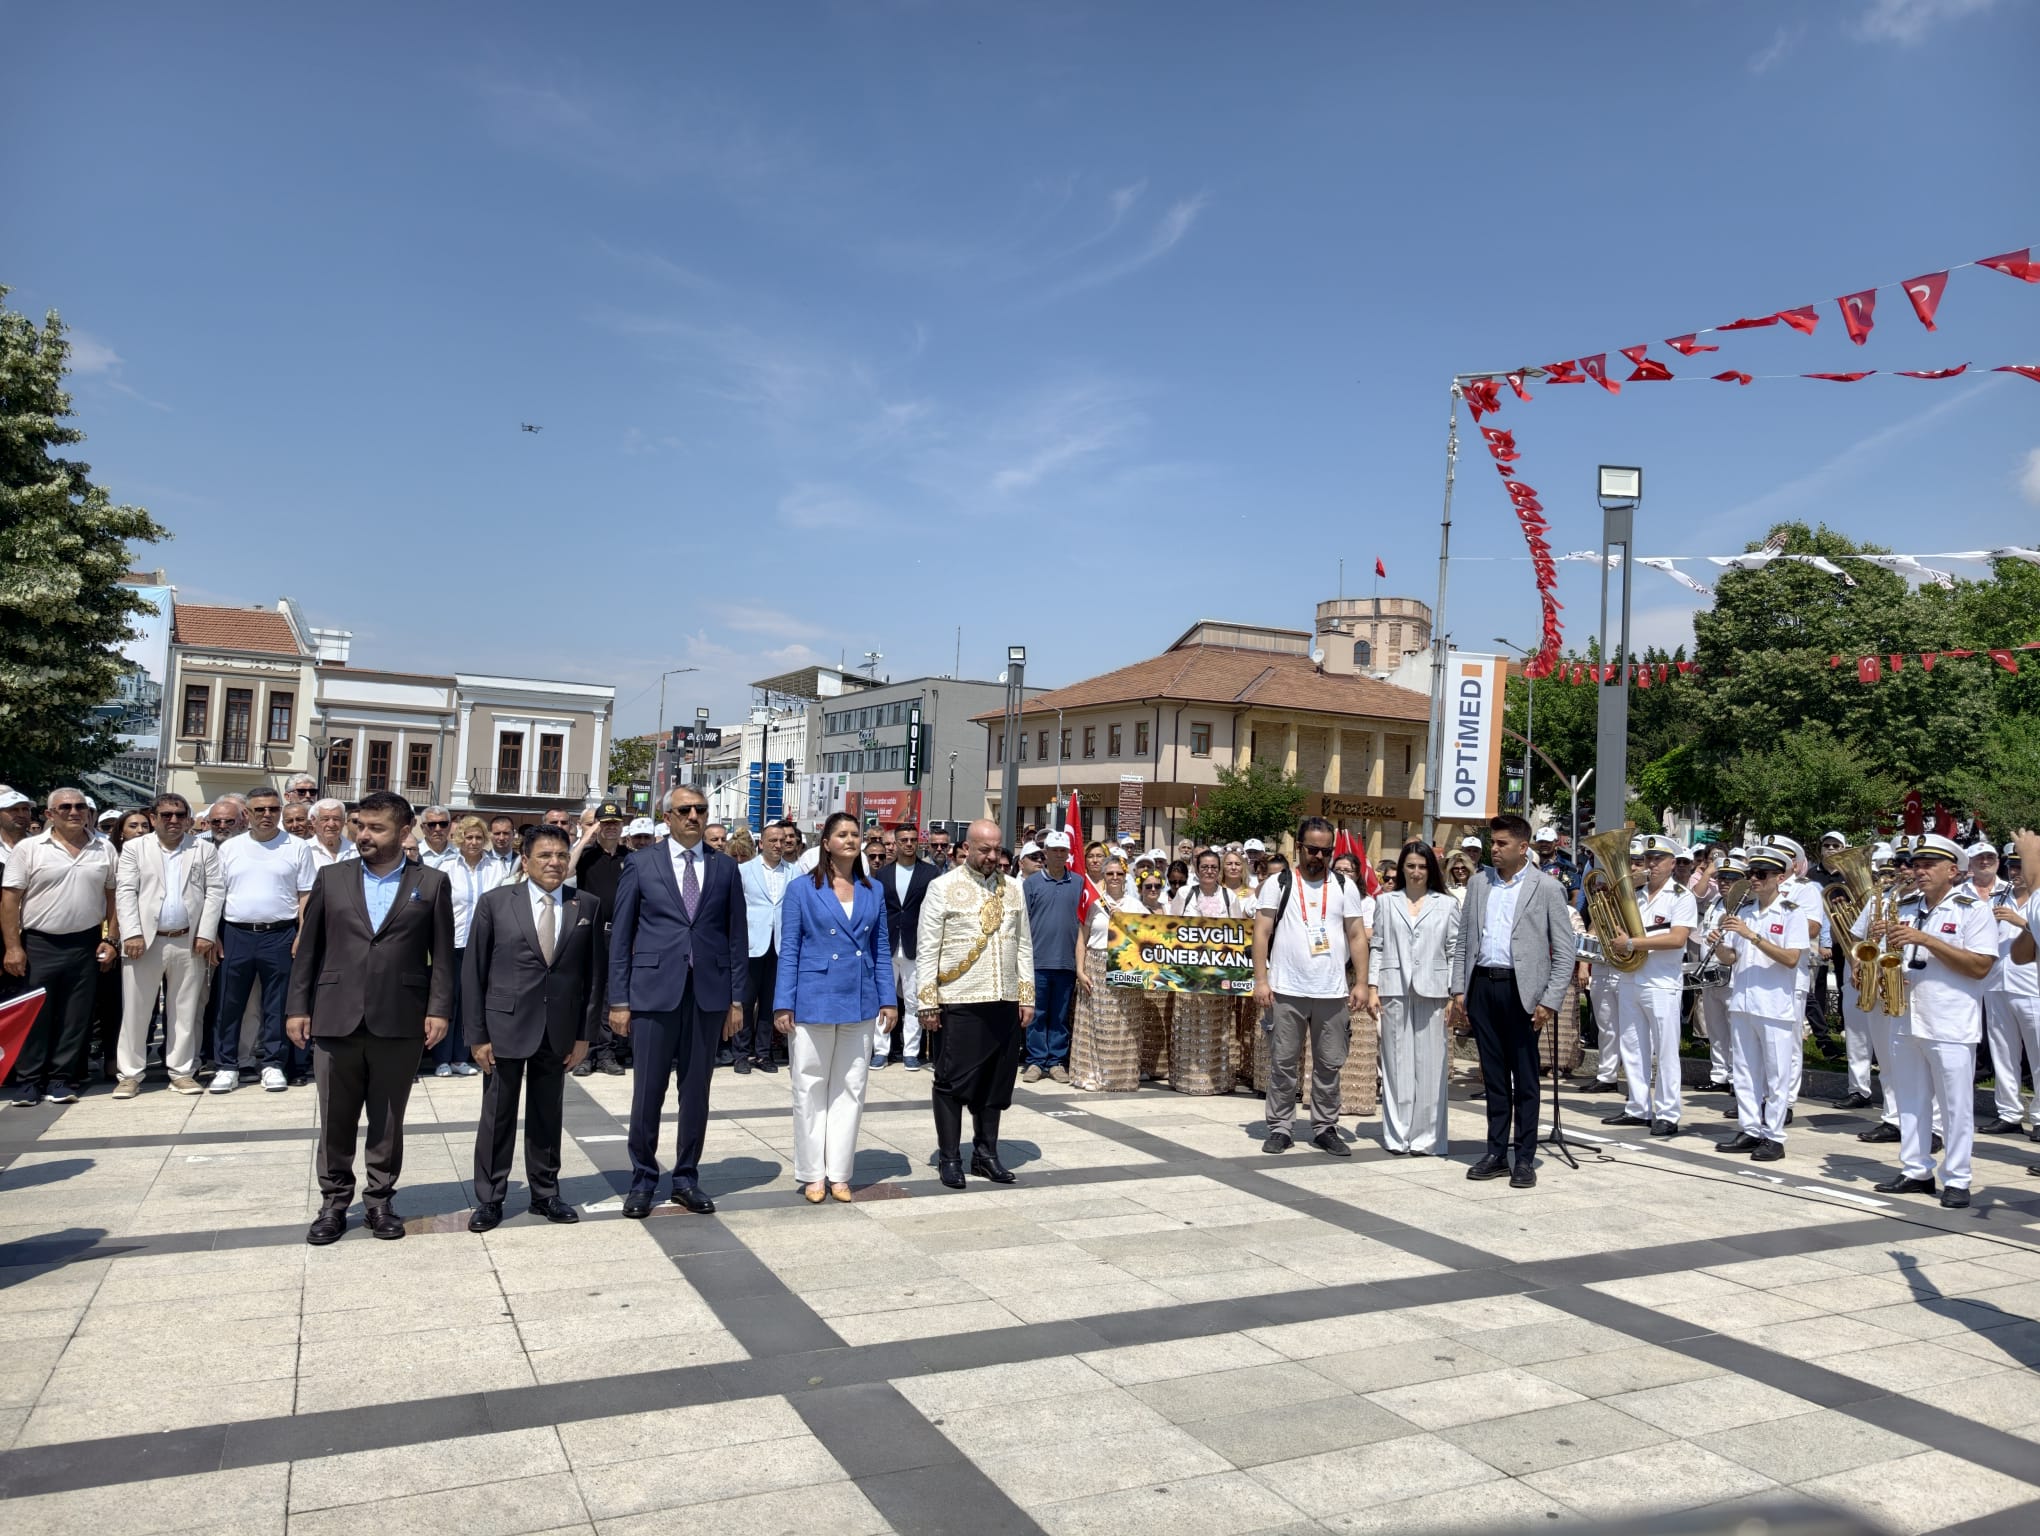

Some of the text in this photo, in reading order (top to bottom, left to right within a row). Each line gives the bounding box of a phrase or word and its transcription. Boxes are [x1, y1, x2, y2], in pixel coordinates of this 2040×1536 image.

[909, 710, 919, 784] HOTEL
[1177, 925, 1244, 944] SEVGİLİ
[1142, 944, 1270, 969] GÜNEBAKAN
[1114, 973, 1143, 983] EDİRNE
